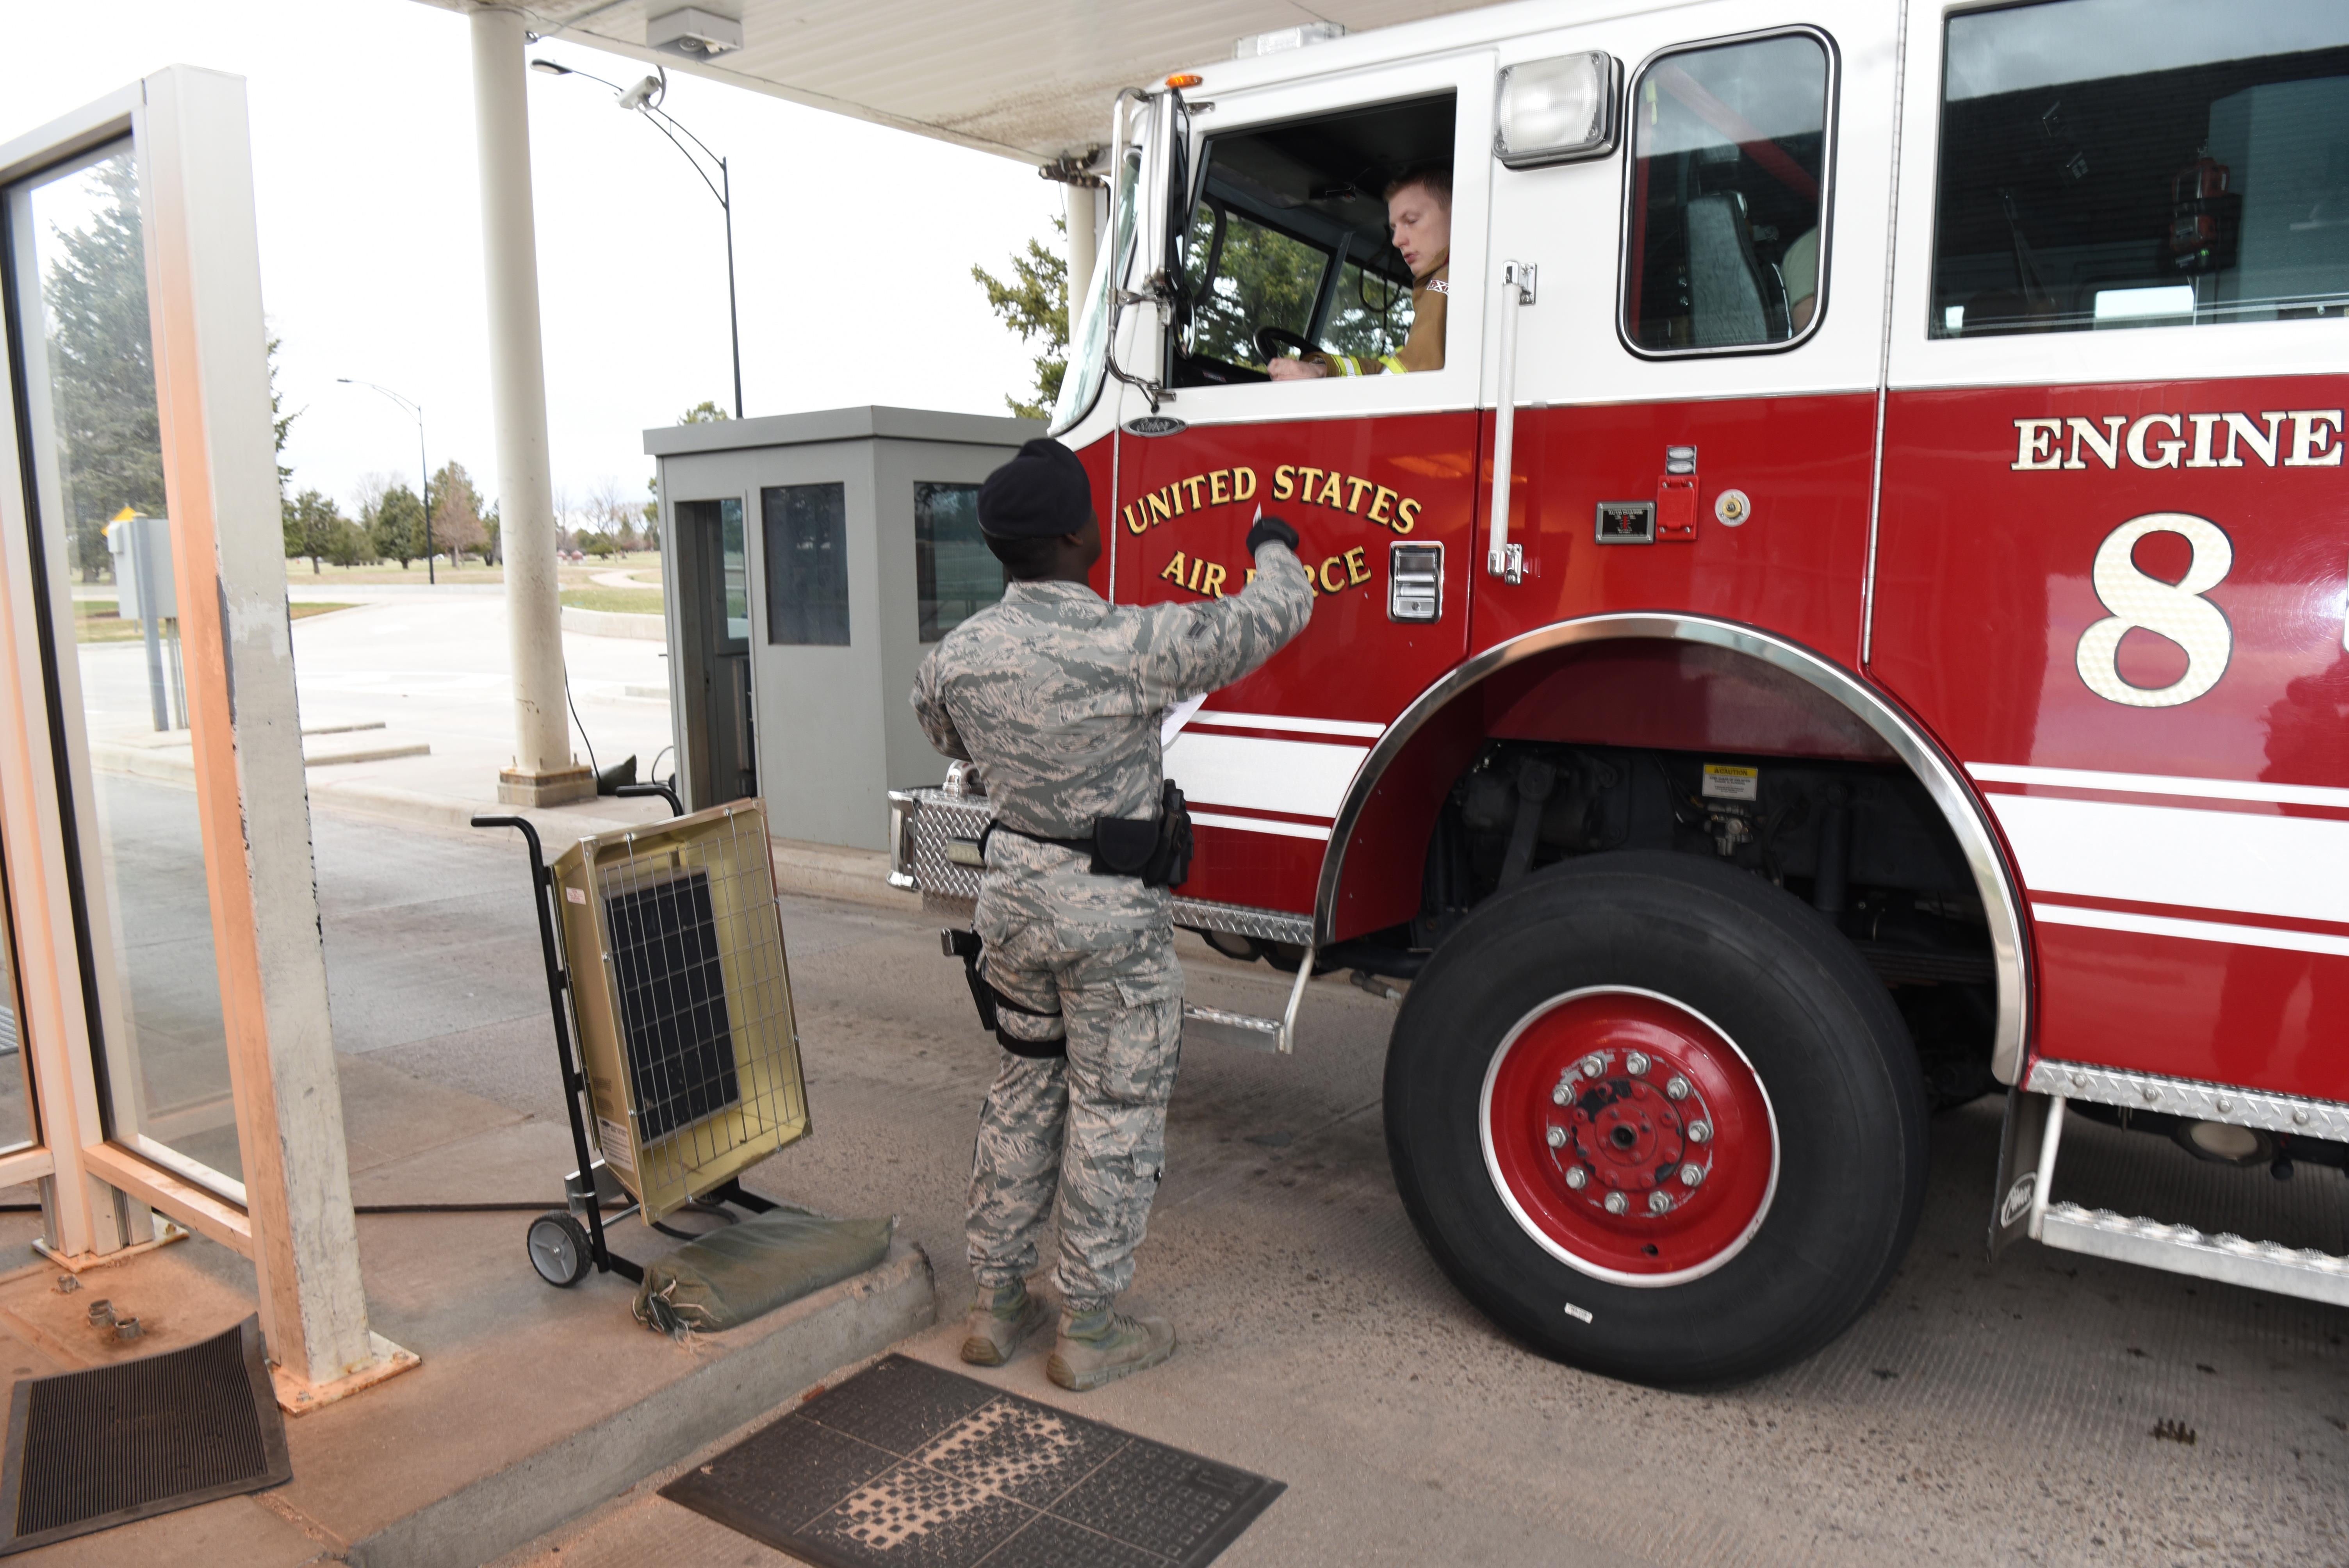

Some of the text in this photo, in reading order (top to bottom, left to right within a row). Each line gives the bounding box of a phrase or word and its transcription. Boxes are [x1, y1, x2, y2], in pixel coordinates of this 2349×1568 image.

[2011, 410, 2342, 470] ENGINE
[1123, 465, 1422, 535] UNITED STATES
[1161, 546, 1372, 598] AIR RCE
[2076, 513, 2233, 707] 8
